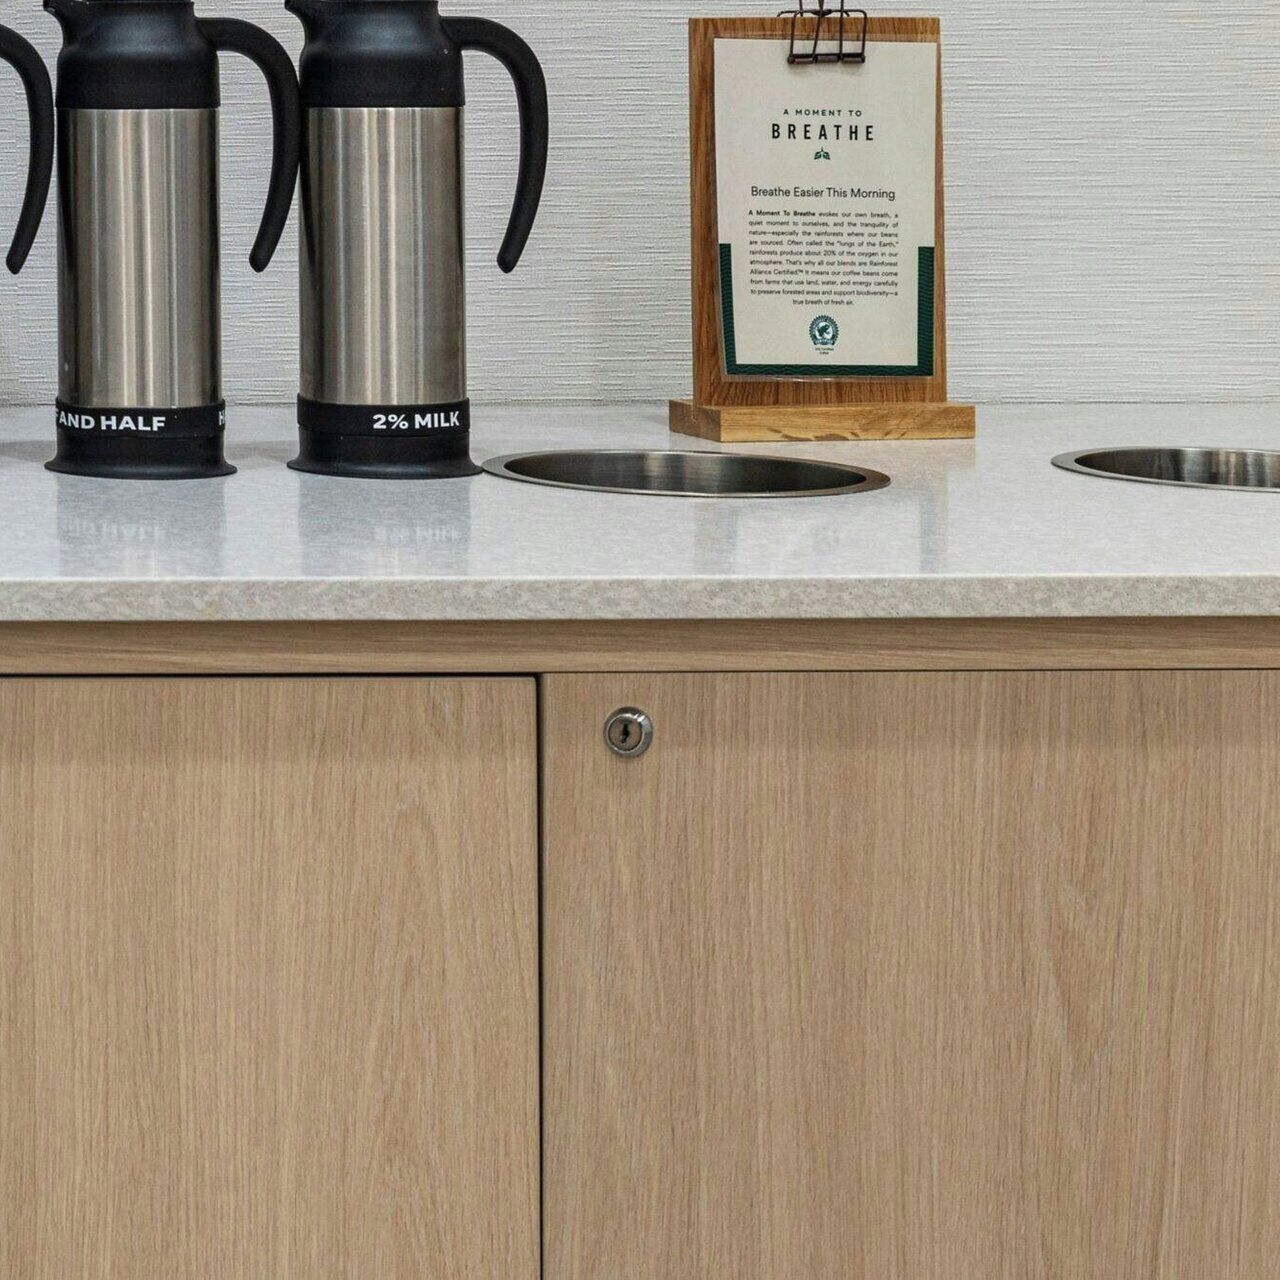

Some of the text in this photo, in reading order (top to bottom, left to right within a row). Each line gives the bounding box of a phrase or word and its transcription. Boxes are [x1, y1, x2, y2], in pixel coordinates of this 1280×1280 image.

[772, 124, 873, 141] BREATHE
[751, 186, 895, 201] Breathe Easier This Morning
[59, 410, 95, 429] AND
[100, 415, 166, 432] HALF
[372, 411, 460, 429] 2% MILK
